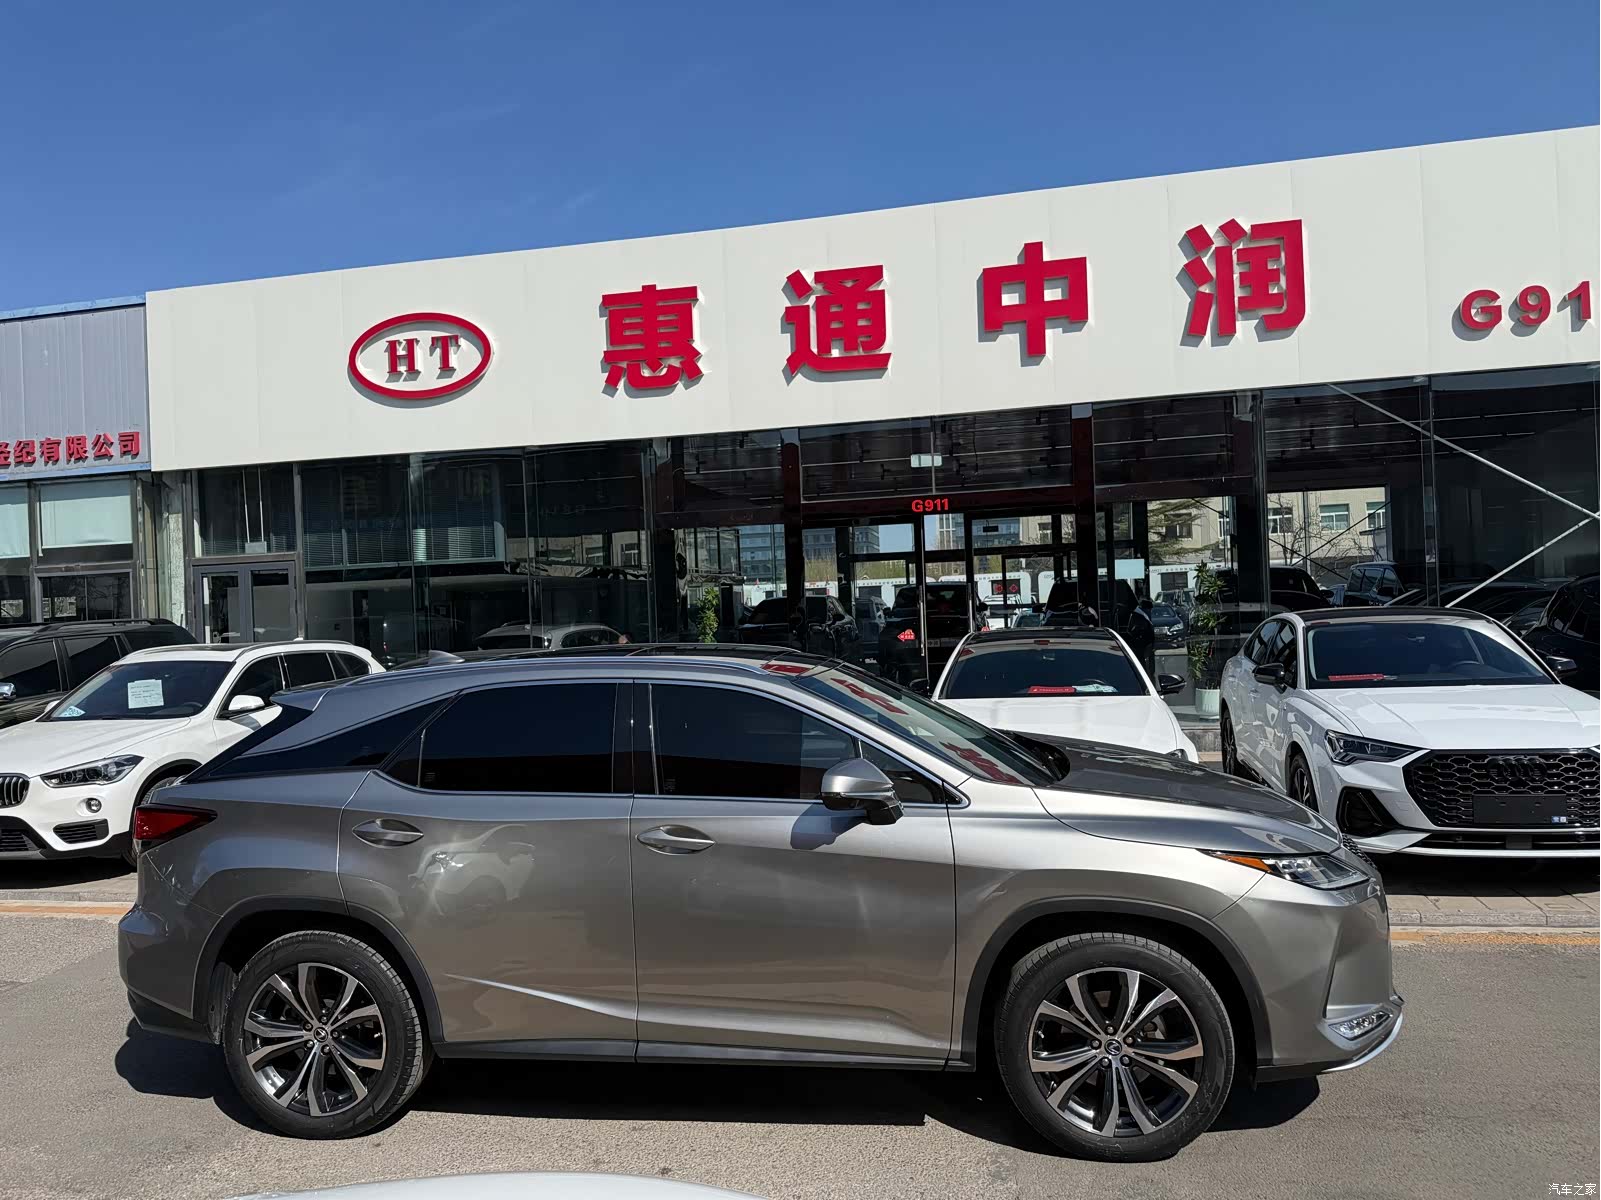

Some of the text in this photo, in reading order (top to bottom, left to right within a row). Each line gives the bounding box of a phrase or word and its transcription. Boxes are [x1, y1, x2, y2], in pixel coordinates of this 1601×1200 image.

[600, 218, 1307, 391] 惠通中润
[385, 334, 460, 374] HT
[911, 498, 949, 513] G911
